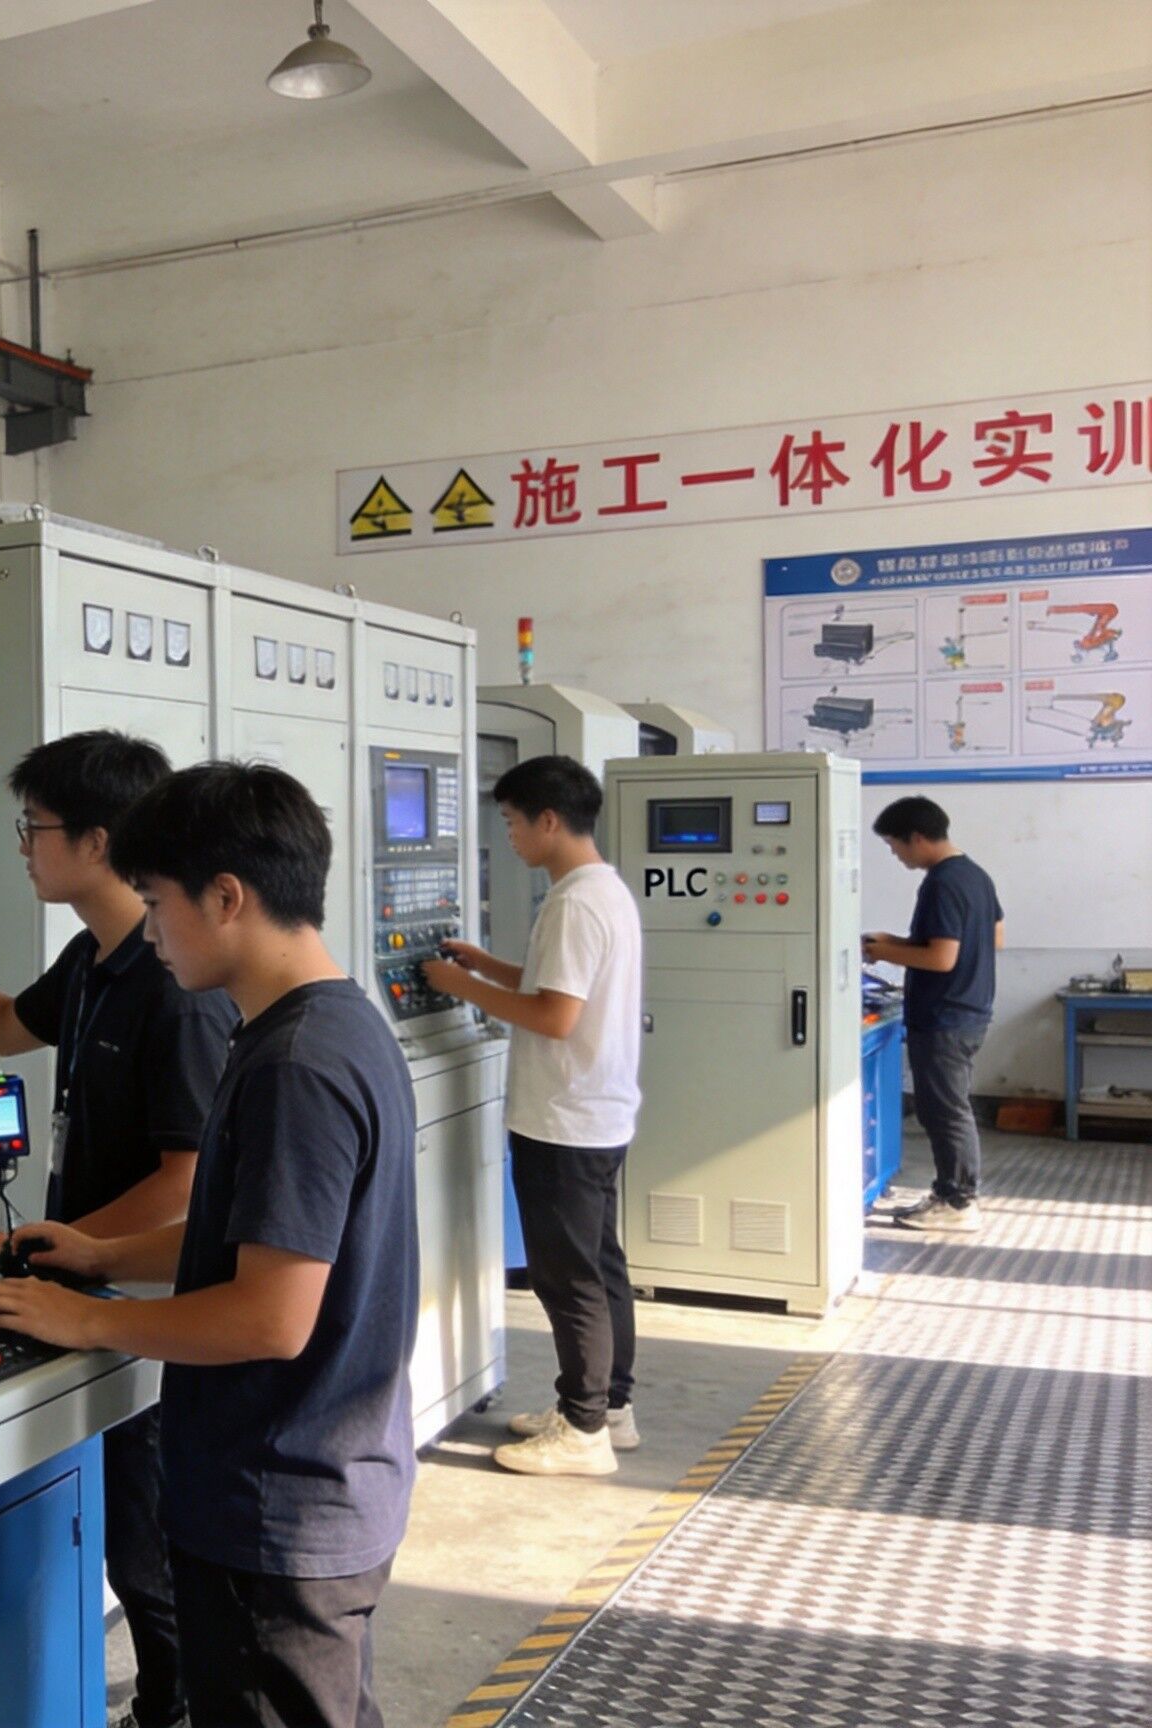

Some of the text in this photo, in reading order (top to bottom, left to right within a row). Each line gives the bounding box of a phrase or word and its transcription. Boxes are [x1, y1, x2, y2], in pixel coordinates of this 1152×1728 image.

[510, 398, 1152, 529] 施工一体化实训
[644, 867, 708, 897] PLC
